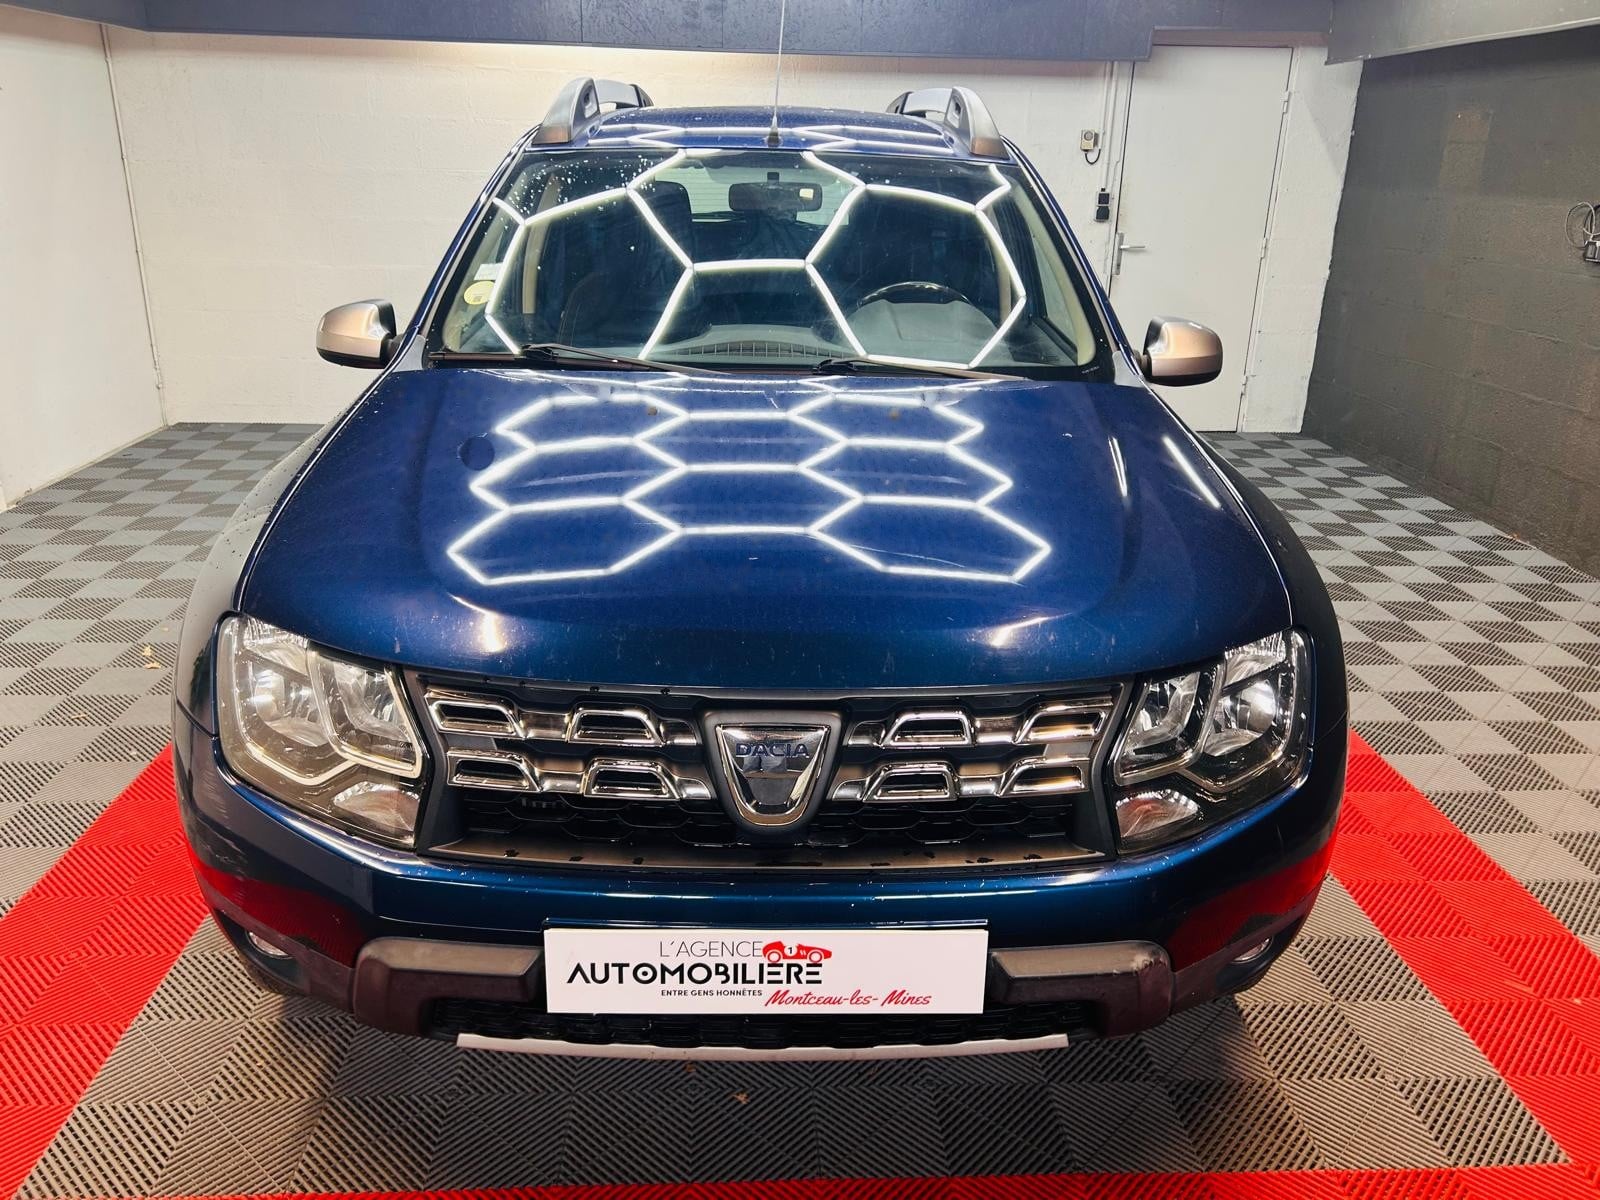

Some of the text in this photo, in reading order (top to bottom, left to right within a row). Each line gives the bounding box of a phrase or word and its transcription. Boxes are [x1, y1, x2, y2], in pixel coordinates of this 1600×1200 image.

[735, 743, 810, 758] DACIA
[659, 941, 763, 958] L'AGENCE
[661, 987, 763, 997] ENTRE GENS HONNÊTES
[880, 989, 933, 1007] Mines
